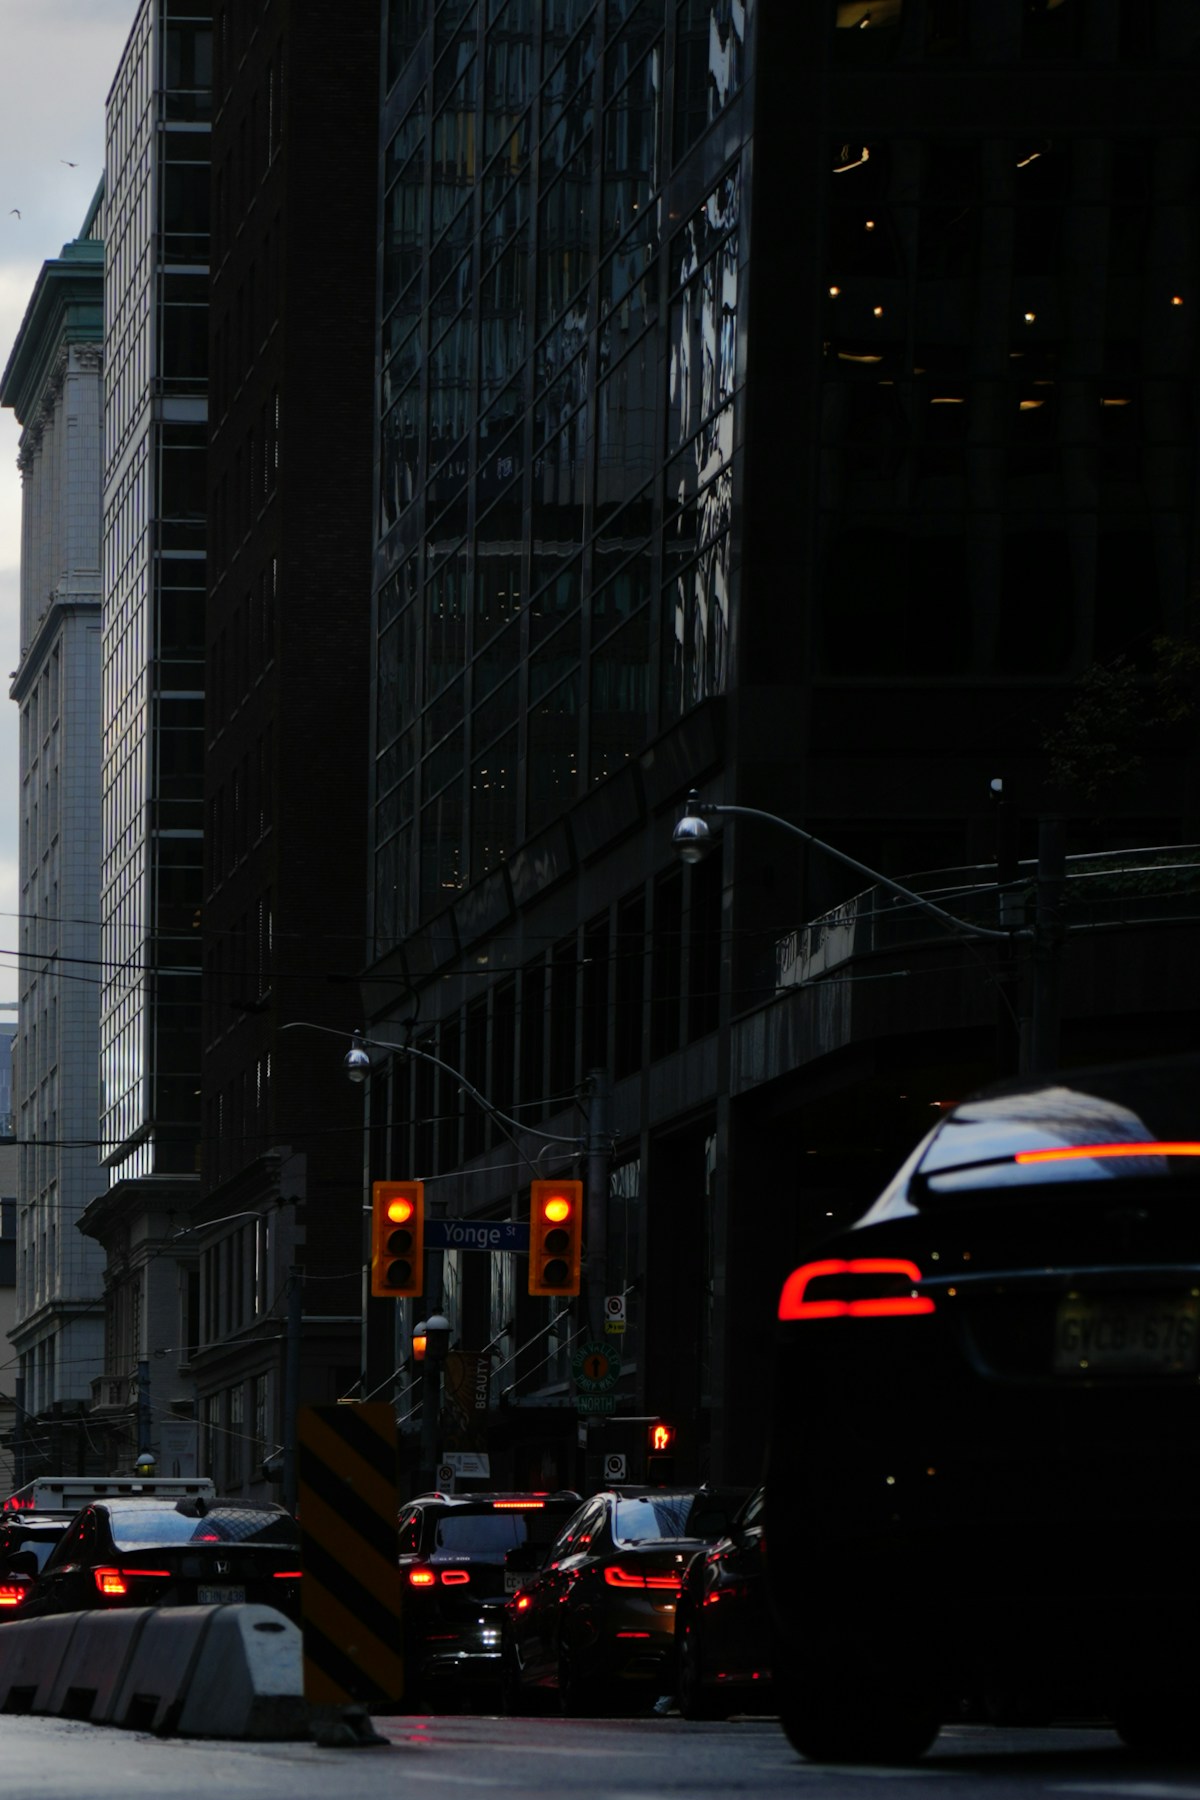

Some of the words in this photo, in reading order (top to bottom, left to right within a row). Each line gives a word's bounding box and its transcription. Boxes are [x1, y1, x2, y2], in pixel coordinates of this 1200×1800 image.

[443, 1222, 501, 1249] Yonge
[505, 1225, 516, 1237] St
[573, 1348, 588, 1367] DON
[587, 1343, 619, 1366] VALLEY
[475, 1358, 488, 1409] BEAUTY
[581, 1397, 612, 1411] NORTH
